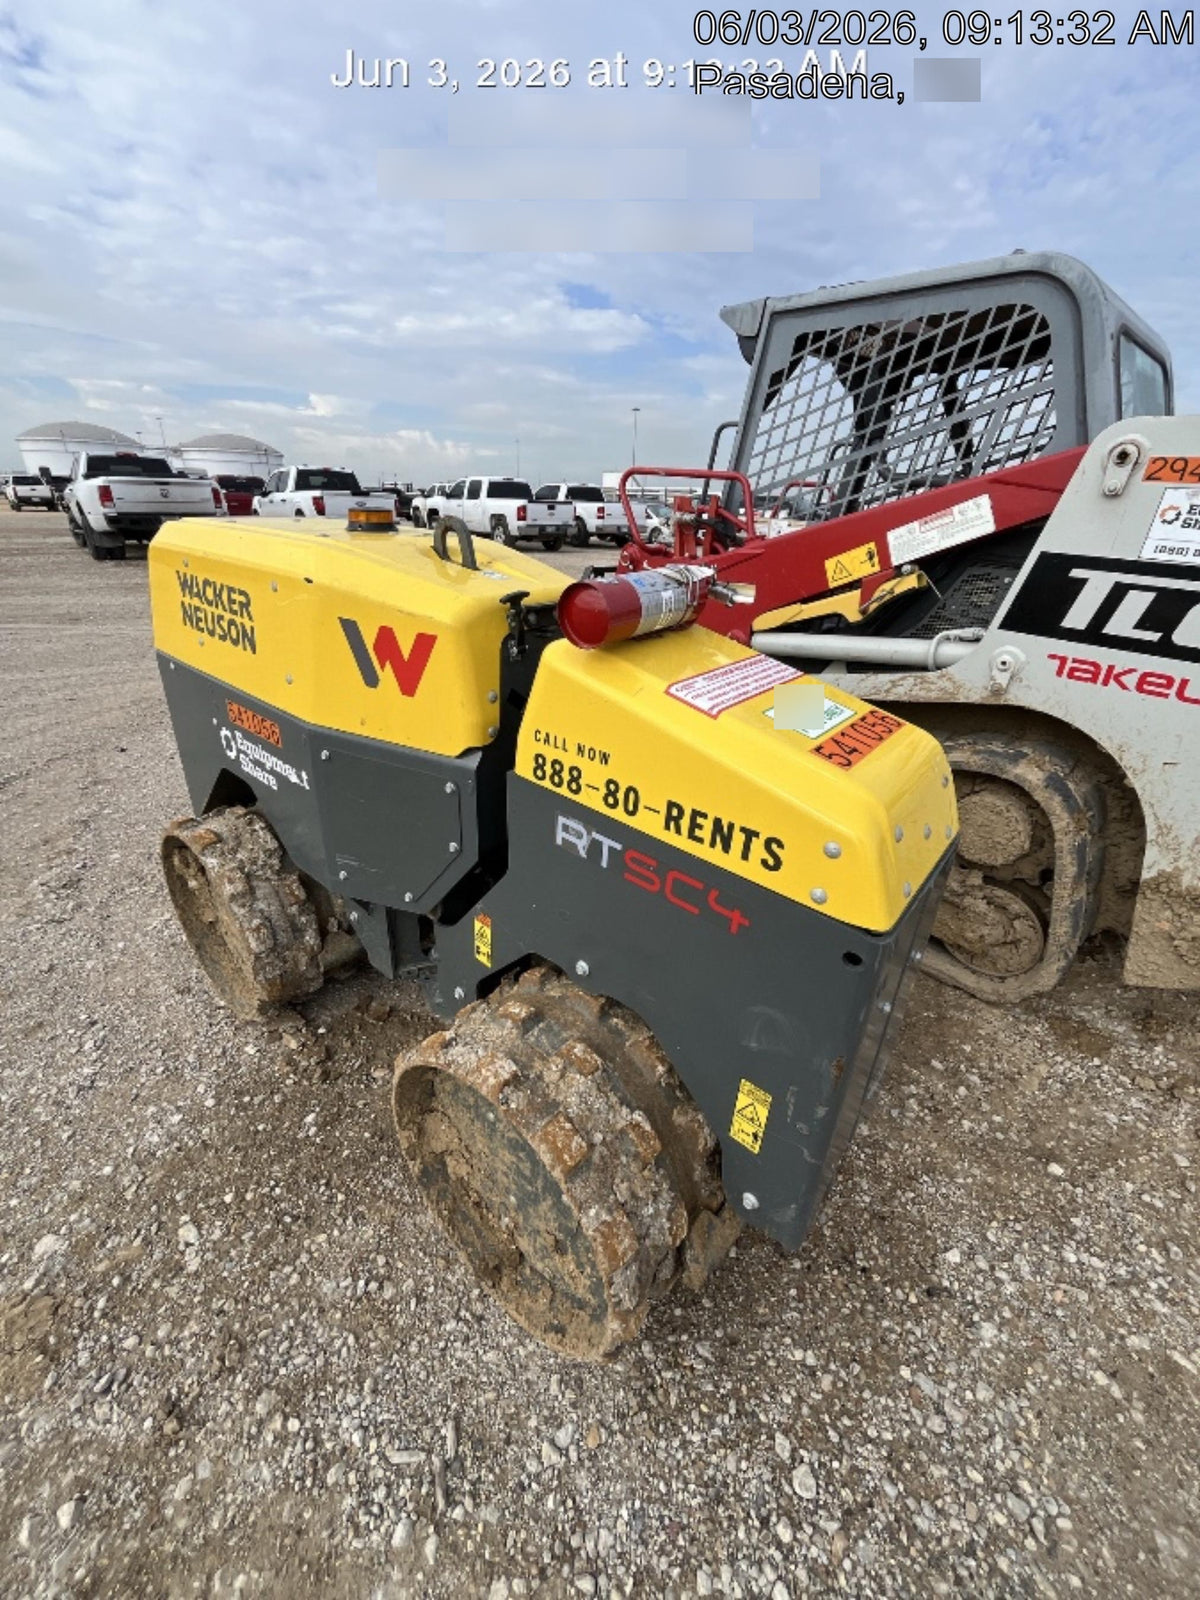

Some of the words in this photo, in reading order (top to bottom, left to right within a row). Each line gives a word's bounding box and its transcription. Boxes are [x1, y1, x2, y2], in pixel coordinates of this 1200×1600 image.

[176, 570, 254, 622] WACKER
[181, 600, 256, 655] NEUSON
[533, 728, 568, 753] CALL
[576, 742, 611, 765] NOW
[814, 709, 902, 768] 541056
[239, 753, 278, 790] Share
[532, 753, 785, 872] 888-80-RENTS
